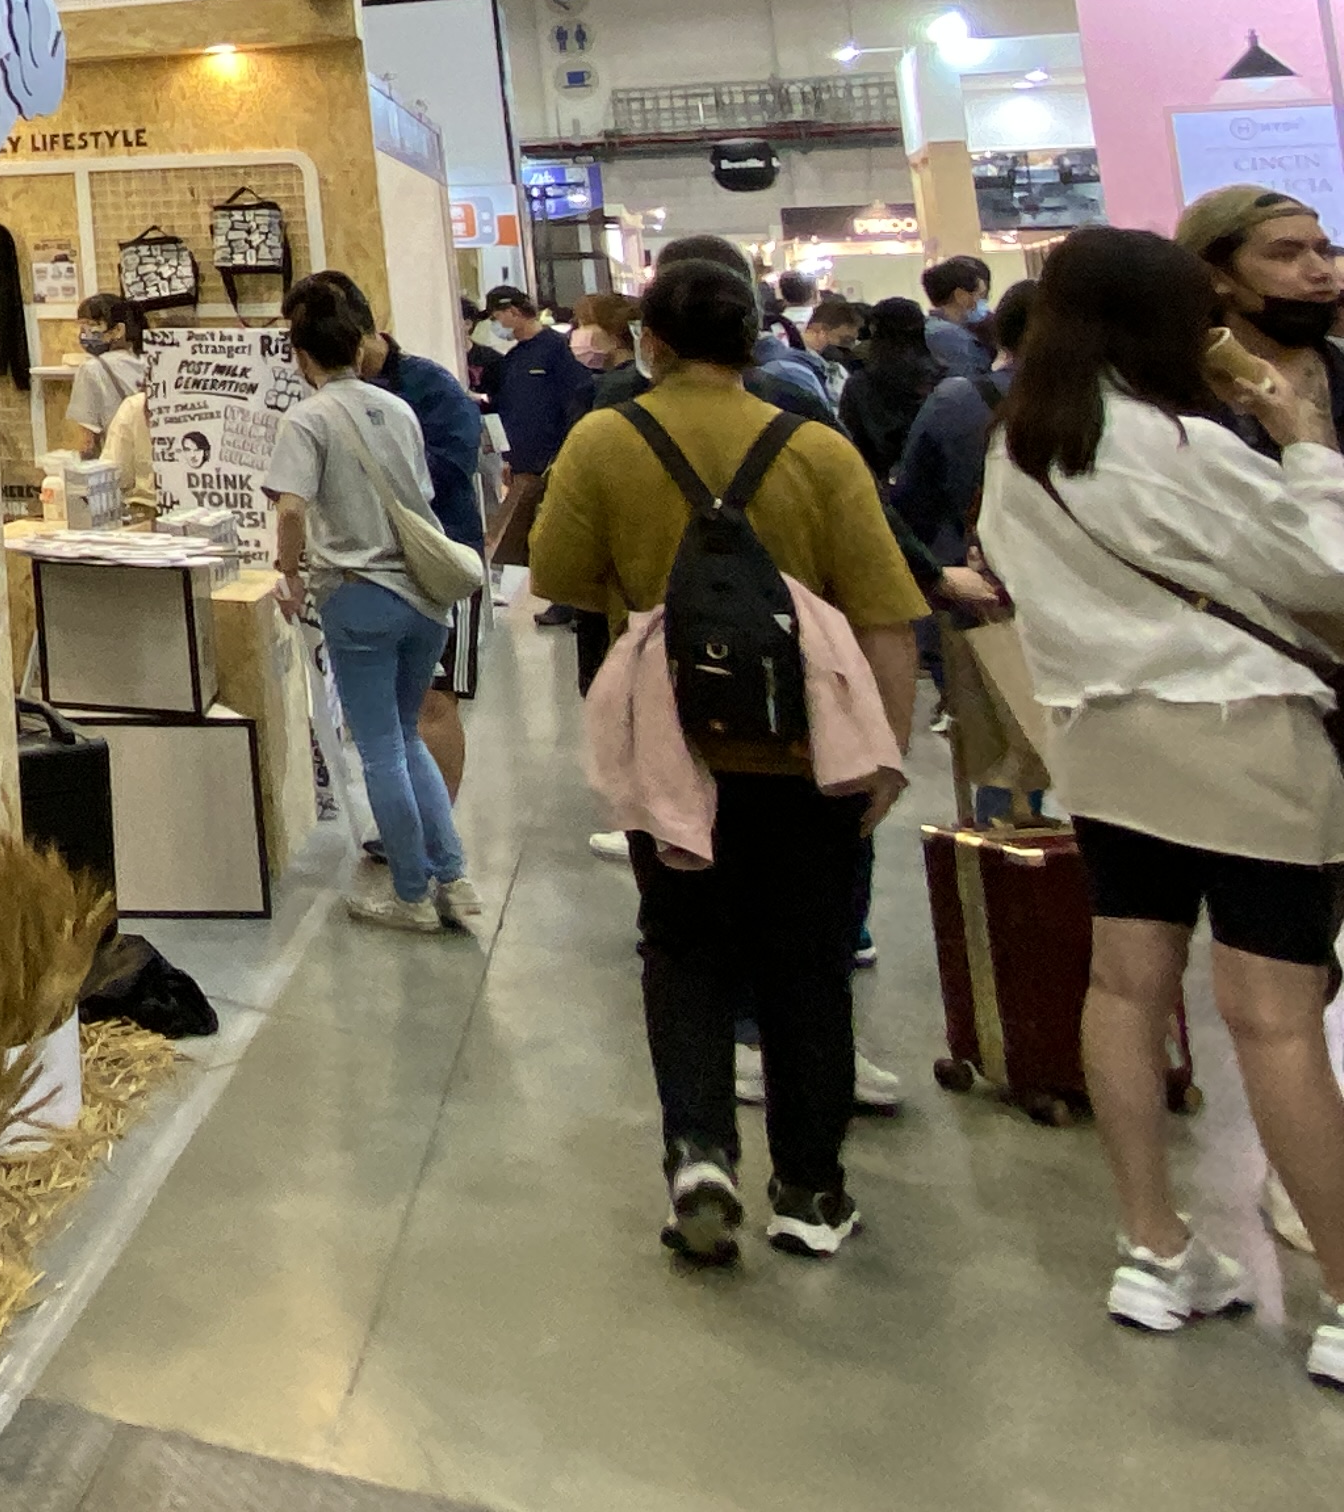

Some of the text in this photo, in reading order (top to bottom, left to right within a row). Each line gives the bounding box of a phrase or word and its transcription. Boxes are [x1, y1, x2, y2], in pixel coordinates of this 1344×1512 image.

[31, 128, 147, 154] LIFESTYLE
[191, 342, 252, 359] stranger!
[178, 360, 253, 380] POST MILK
[174, 375, 260, 395] GENERATION
[192, 491, 253, 509] YOUR
